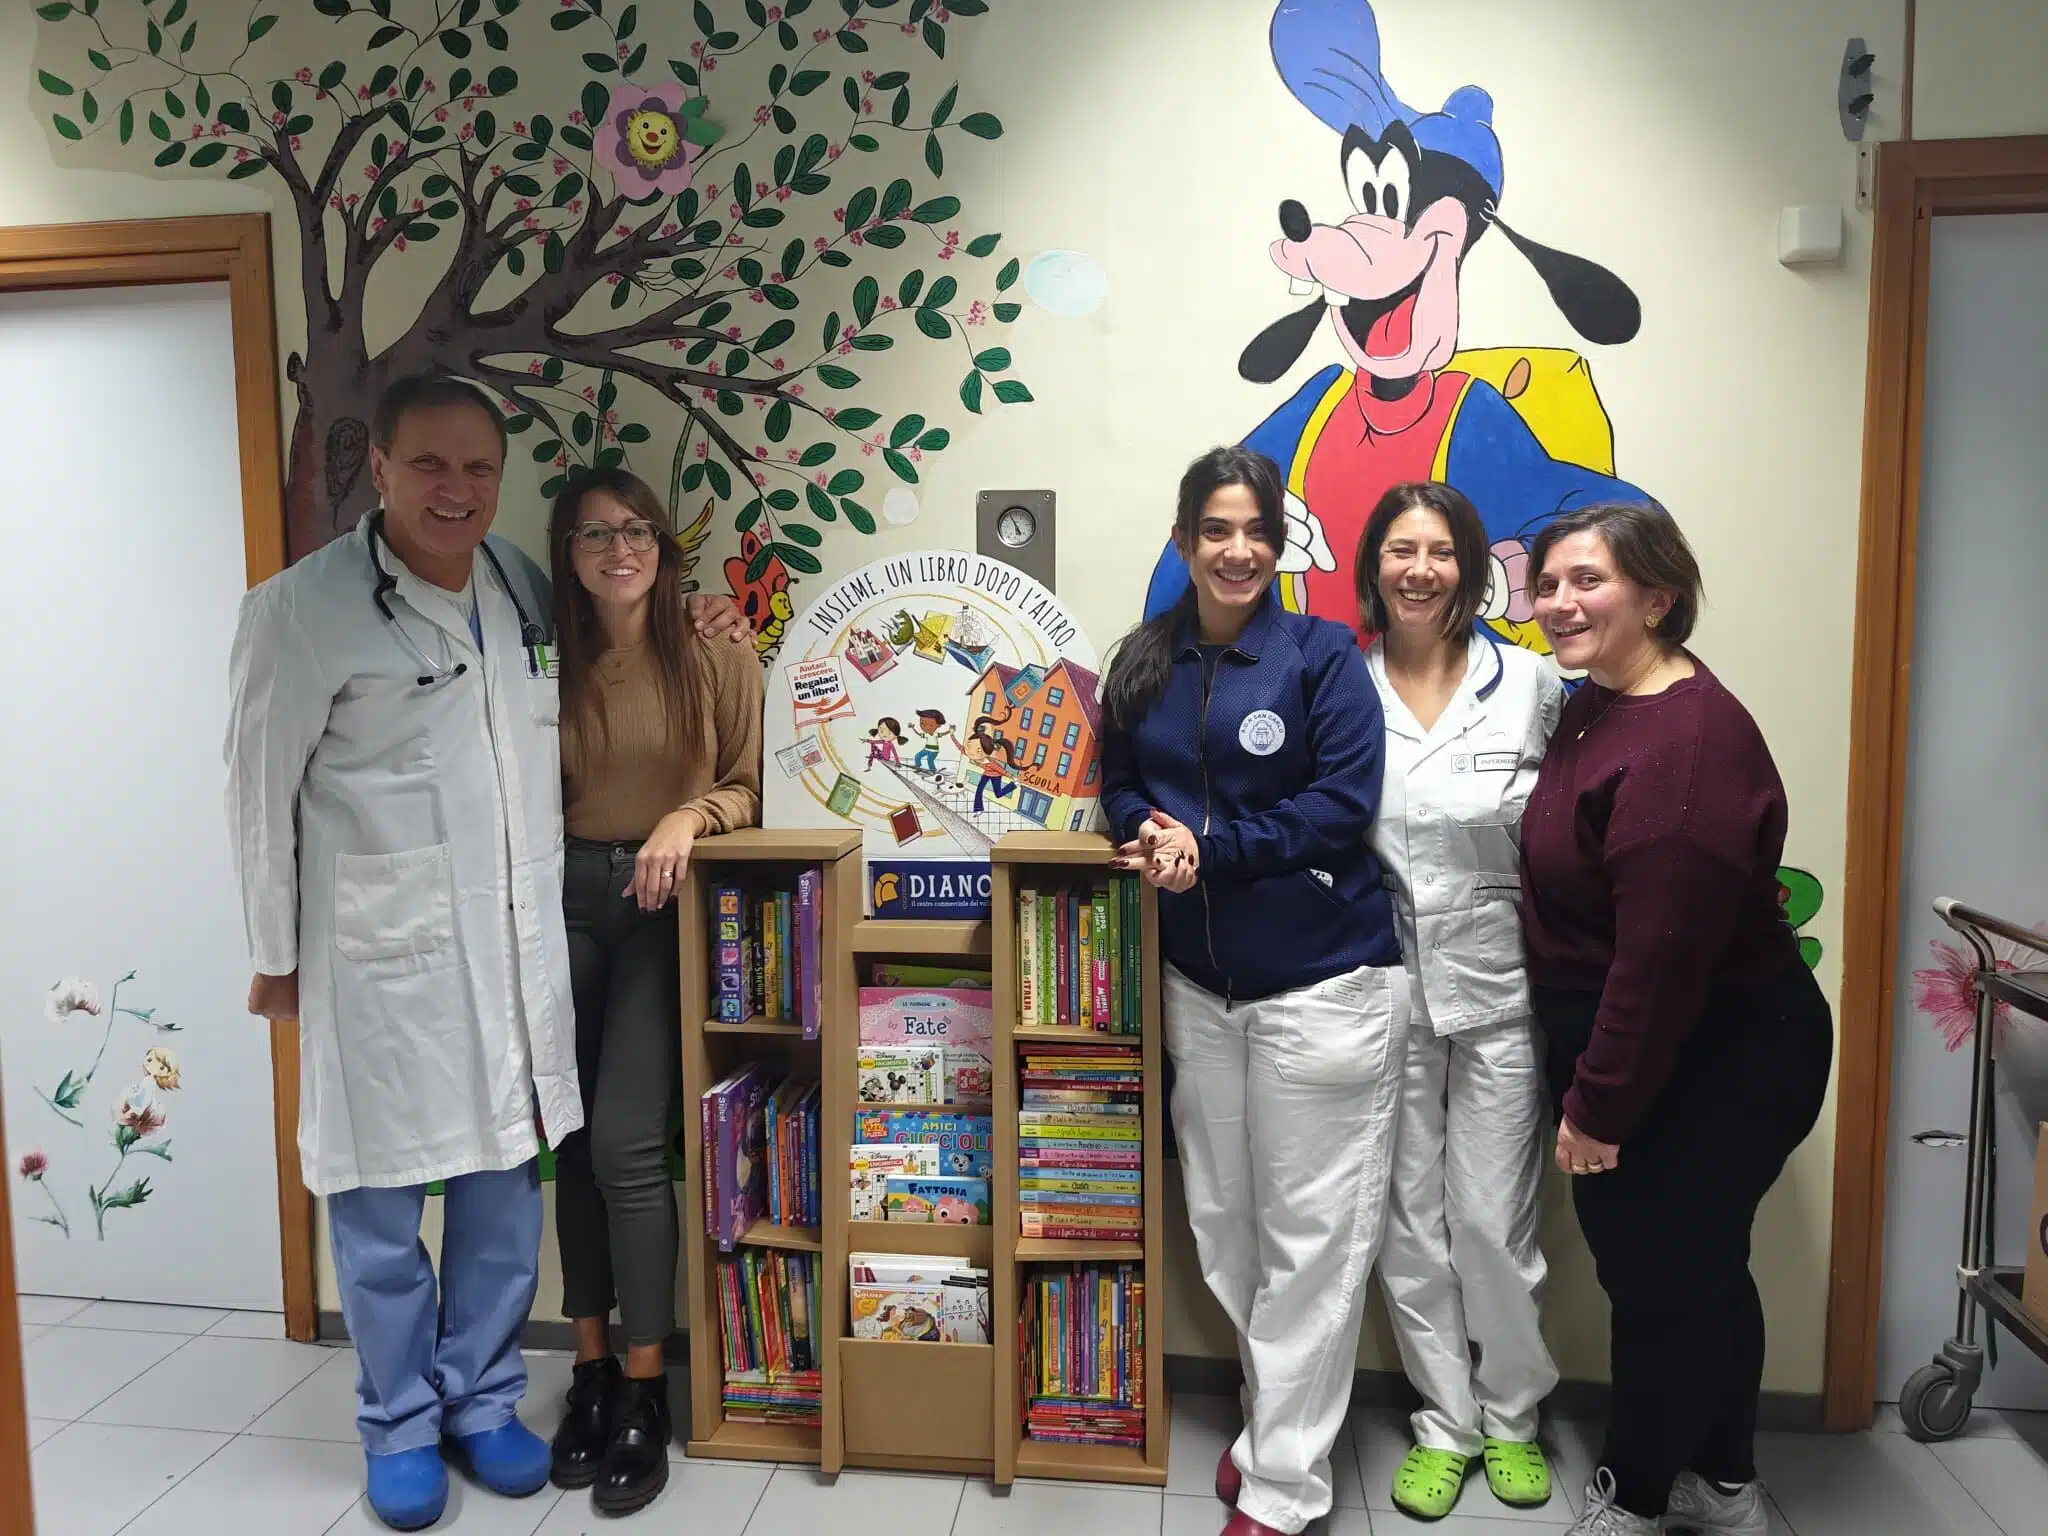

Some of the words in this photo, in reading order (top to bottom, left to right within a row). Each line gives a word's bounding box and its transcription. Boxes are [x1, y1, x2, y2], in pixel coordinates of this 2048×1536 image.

[808, 571, 885, 636] INSIEME,
[885, 558, 913, 588] UN
[919, 556, 968, 584] LIBRO
[973, 562, 1021, 601] DOPO
[1018, 587, 1076, 653] L'ALTRO.
[799, 667, 836, 680] crescere.
[800, 661, 827, 673] Aiutaci
[794, 673, 839, 691] Regalaci
[797, 692, 811, 701] un
[811, 683, 840, 698] libro!
[1023, 771, 1060, 794] SCUOLA
[909, 874, 992, 898] DIANO
[1096, 906, 1107, 929] PIPPO
[903, 1016, 947, 1035] Fate
[922, 1122, 957, 1131] AMICI
[908, 1182, 967, 1196] FATTORIA
